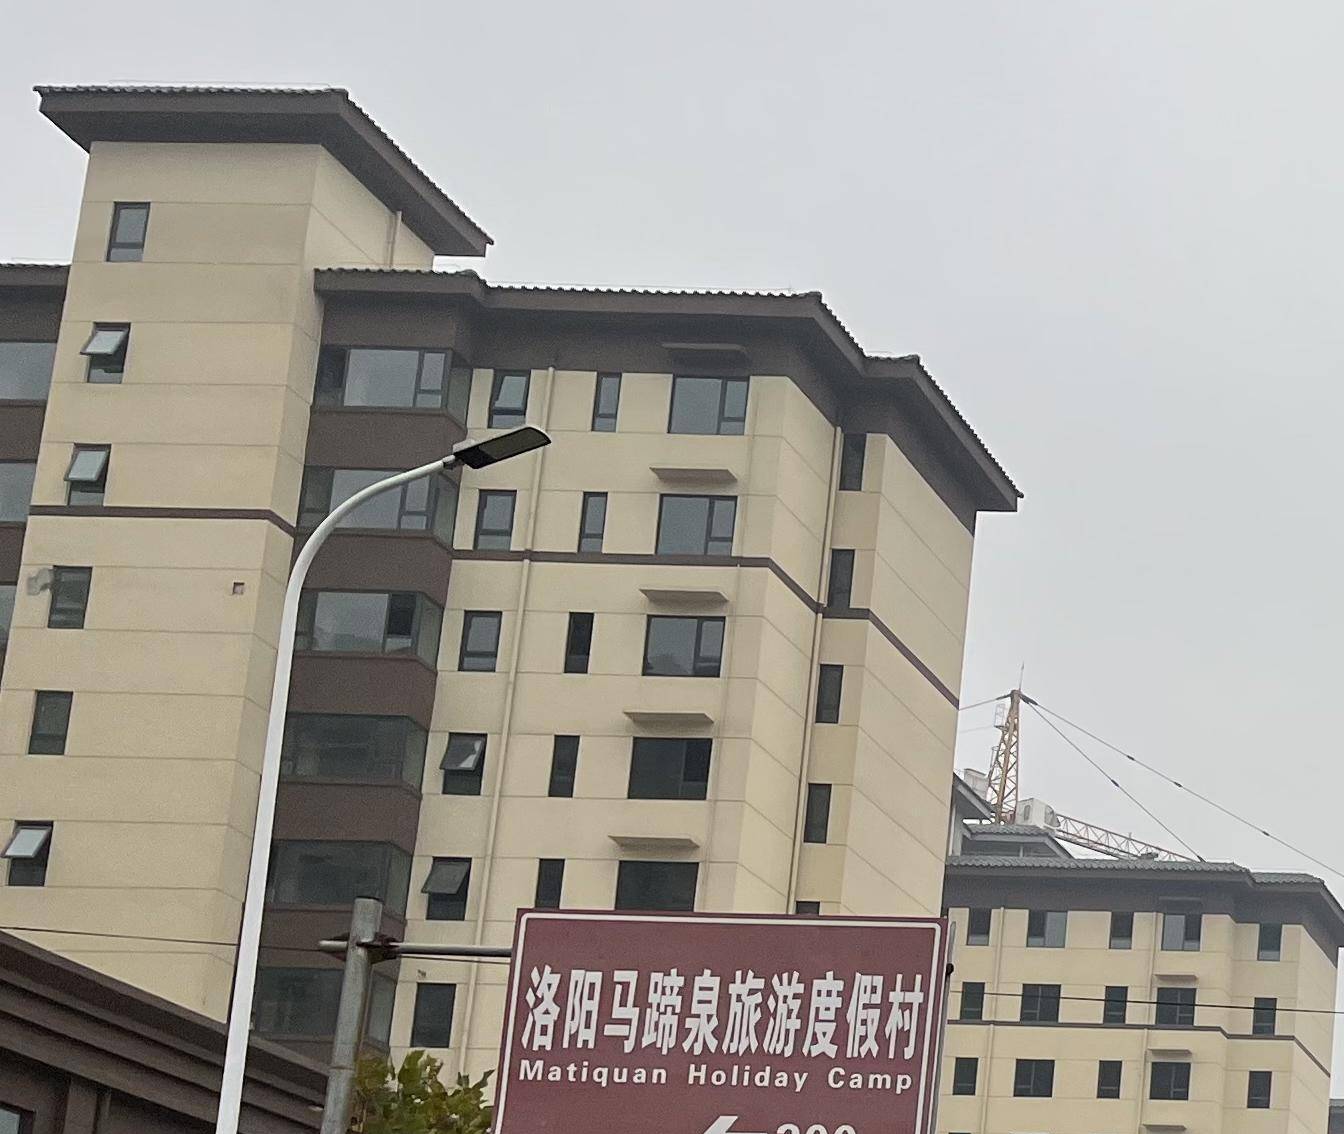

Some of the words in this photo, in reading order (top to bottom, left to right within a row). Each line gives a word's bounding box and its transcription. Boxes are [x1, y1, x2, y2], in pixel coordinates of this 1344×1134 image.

[520, 963, 925, 1060] 洛阳马蹄泉旅游度假村
[518, 1059, 668, 1086] Matiquan
[687, 1063, 809, 1093] Holiday
[827, 1067, 913, 1095] Camp
